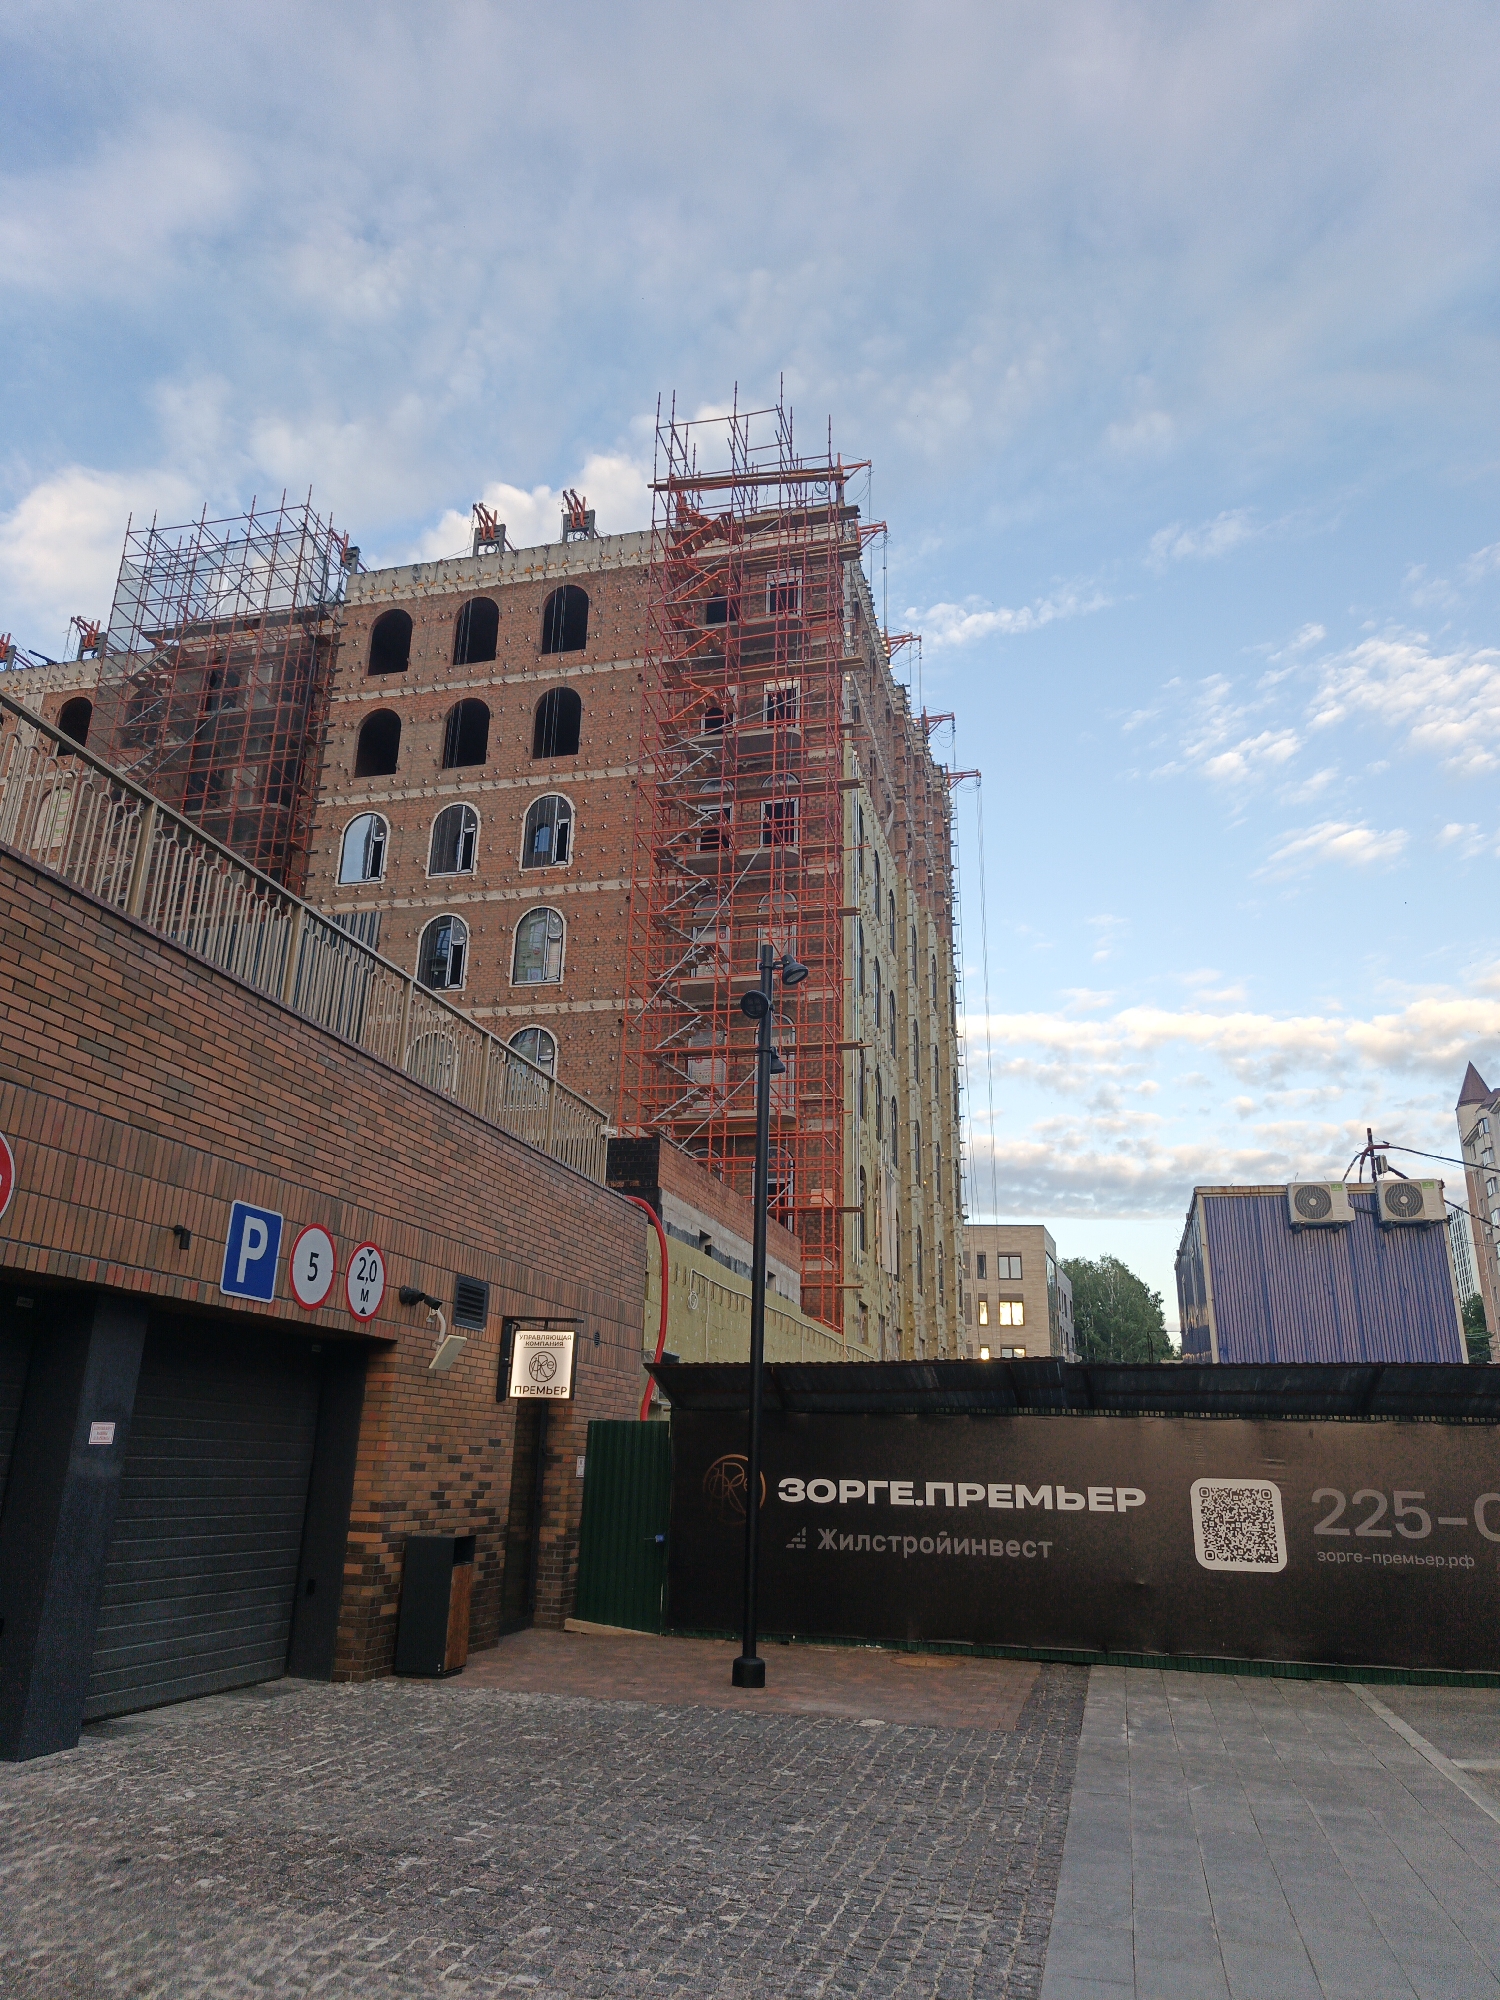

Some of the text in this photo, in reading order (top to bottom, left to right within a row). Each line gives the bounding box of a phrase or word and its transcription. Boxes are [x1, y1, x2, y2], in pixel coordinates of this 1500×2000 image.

[236, 1215, 268, 1283] P
[307, 1251, 320, 1282] 5
[356, 1256, 378, 1284] 2,0
[519, 1334, 572, 1342] УПРАВЛЯЮЩАЯ
[514, 1385, 568, 1395] ПРЕМЬЕР
[778, 1477, 1146, 1512] ЗОРГЕ.ПРЕМЬЕР
[817, 1528, 1053, 1558] Жилстройинвест
[1317, 1551, 1475, 1569] зорге-премьер.рф
